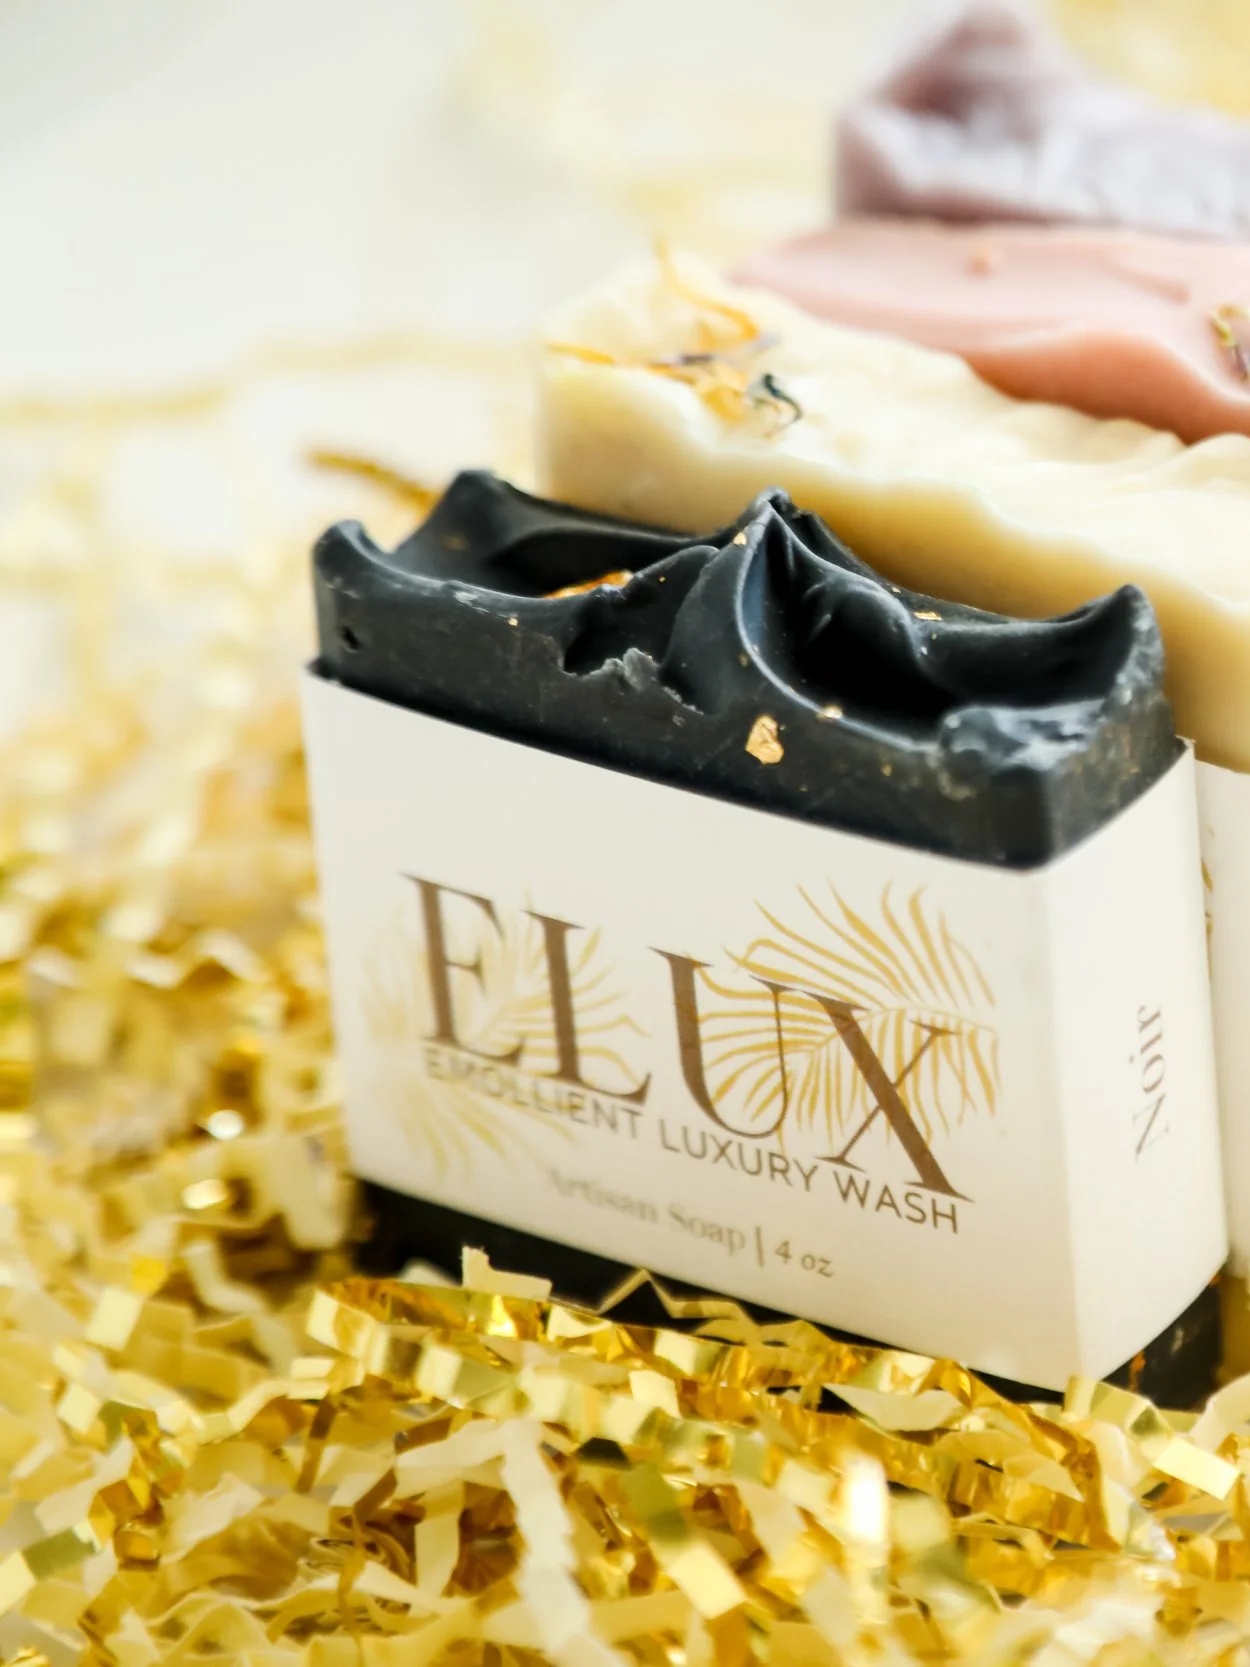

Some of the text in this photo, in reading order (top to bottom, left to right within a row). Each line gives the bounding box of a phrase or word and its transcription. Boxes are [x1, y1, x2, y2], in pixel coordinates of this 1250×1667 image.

[398, 872, 976, 1203] ELUX
[1129, 1003, 1170, 1161] Noir
[424, 1046, 959, 1234] EMOLLIENT LUXURY WASH
[547, 1166, 660, 1225] Artisan
[668, 1201, 747, 1256] Soap
[773, 1239, 793, 1265] 4
[801, 1252, 836, 1279] oz
